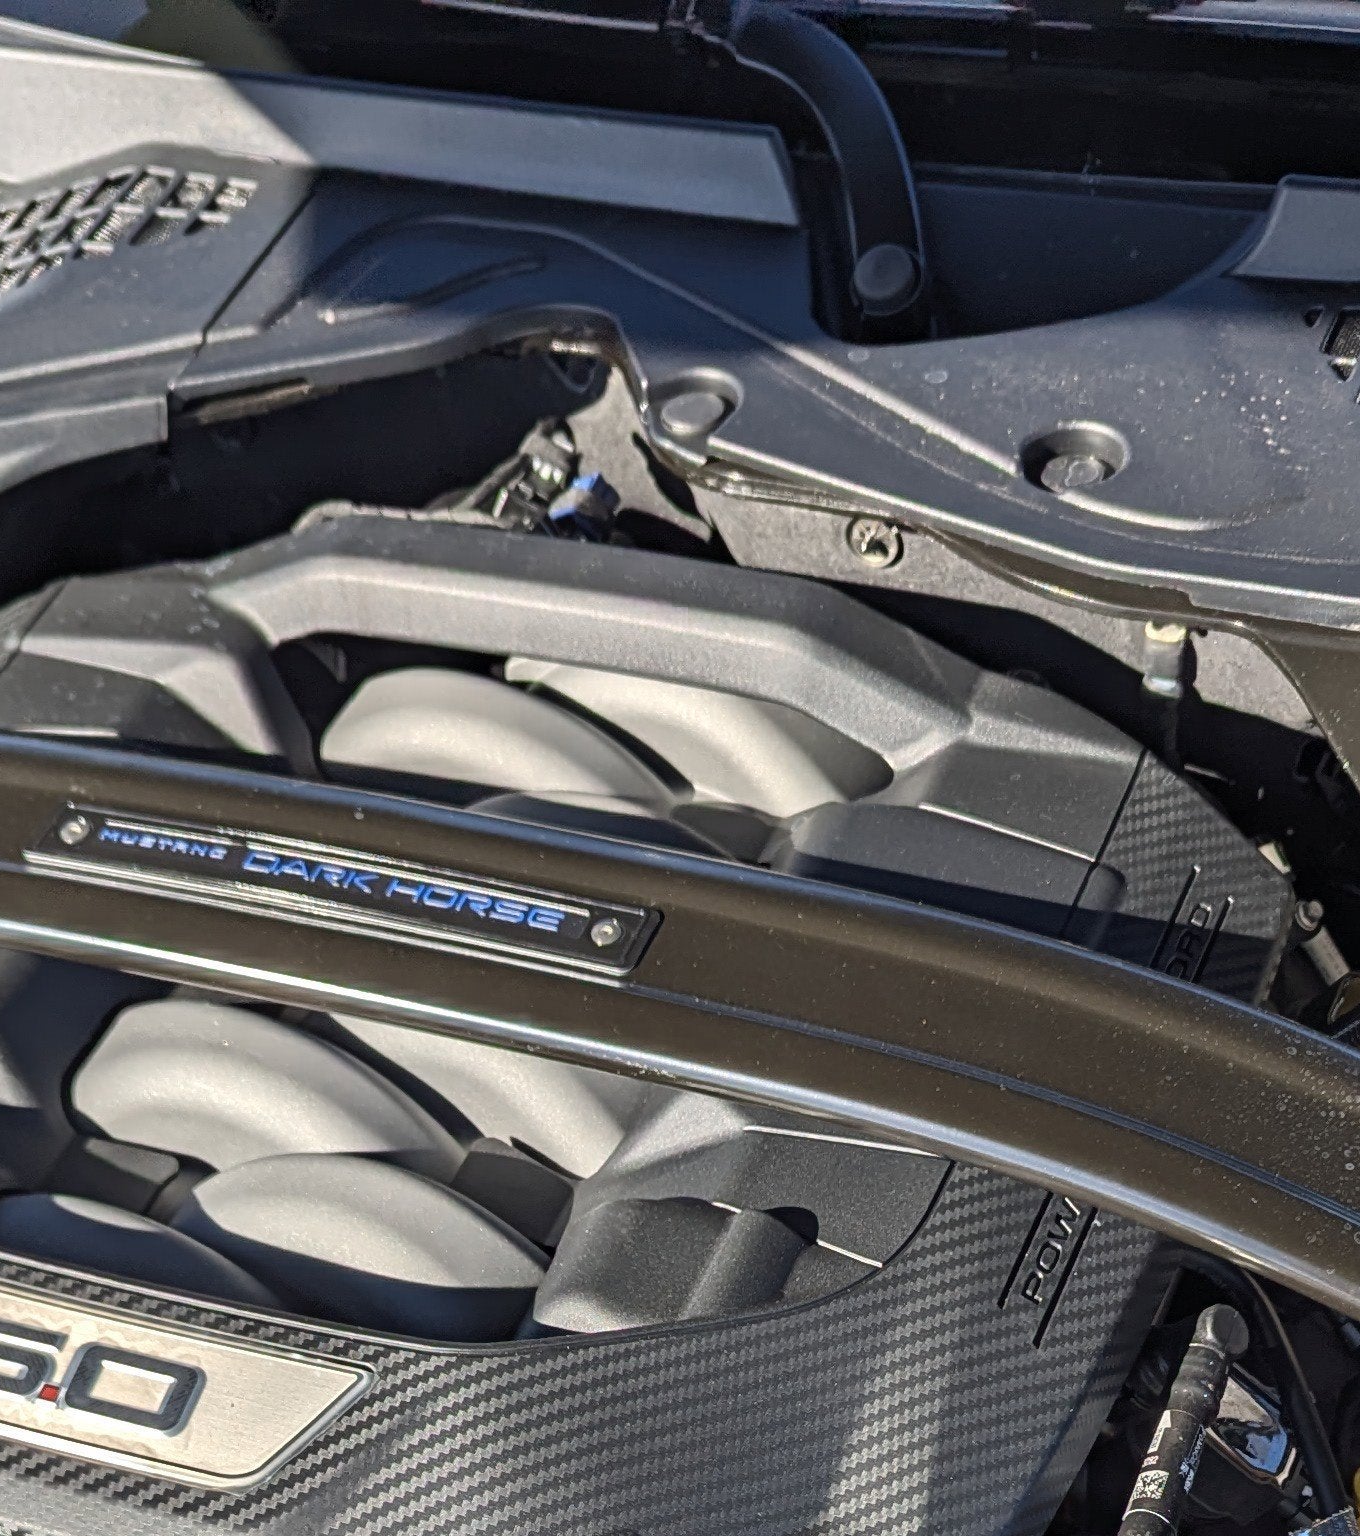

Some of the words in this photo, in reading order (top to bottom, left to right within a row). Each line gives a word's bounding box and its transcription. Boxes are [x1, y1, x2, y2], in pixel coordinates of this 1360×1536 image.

[99, 827, 227, 859] MUSTANG
[242, 850, 380, 893] DARK
[385, 878, 565, 933] HORSE
[1021, 1196, 1081, 1306] POW
